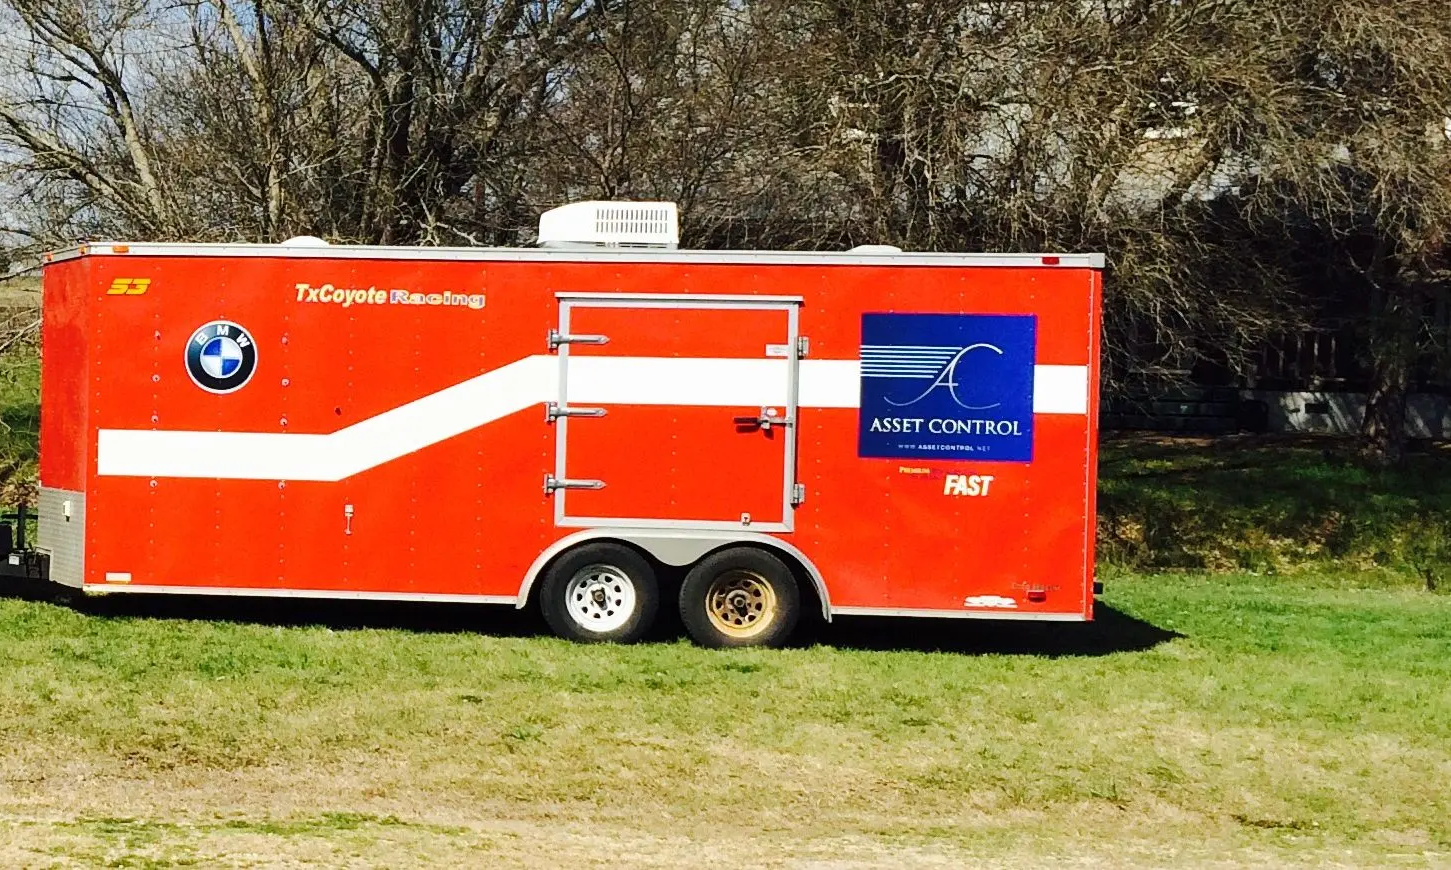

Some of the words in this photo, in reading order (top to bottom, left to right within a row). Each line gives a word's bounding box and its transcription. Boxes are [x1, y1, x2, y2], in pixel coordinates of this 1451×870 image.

[295, 283, 387, 307] TxCoyote
[390, 289, 486, 309] Racing
[195, 324, 251, 348] BMW
[870, 417, 924, 433] ASSET
[928, 418, 1023, 436] CONTROL
[943, 474, 995, 497] FAST
